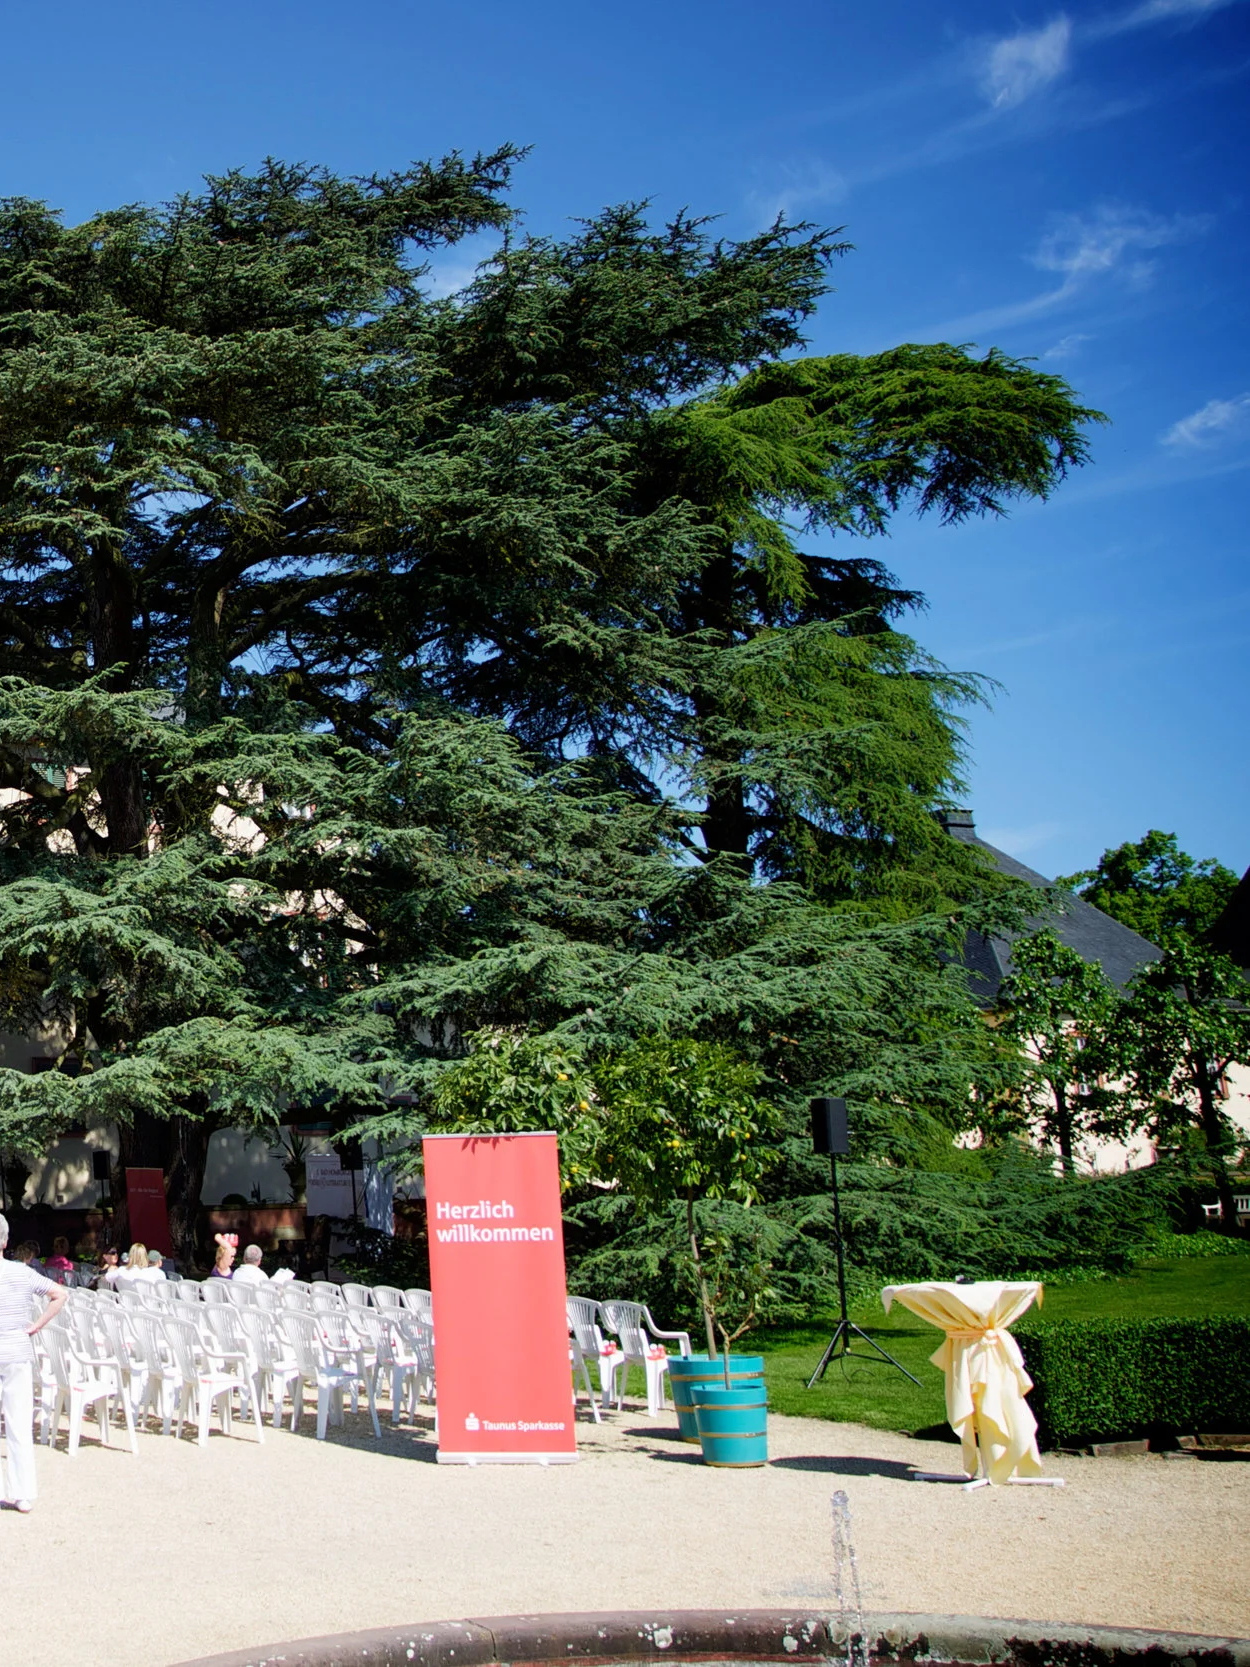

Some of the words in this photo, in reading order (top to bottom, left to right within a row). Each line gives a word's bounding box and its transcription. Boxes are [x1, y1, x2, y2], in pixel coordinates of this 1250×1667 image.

[436, 1200, 514, 1219] Herzlich
[436, 1224, 554, 1242] willkommen
[482, 1420, 516, 1431] Taunus
[517, 1420, 565, 1432] Sparkasse
